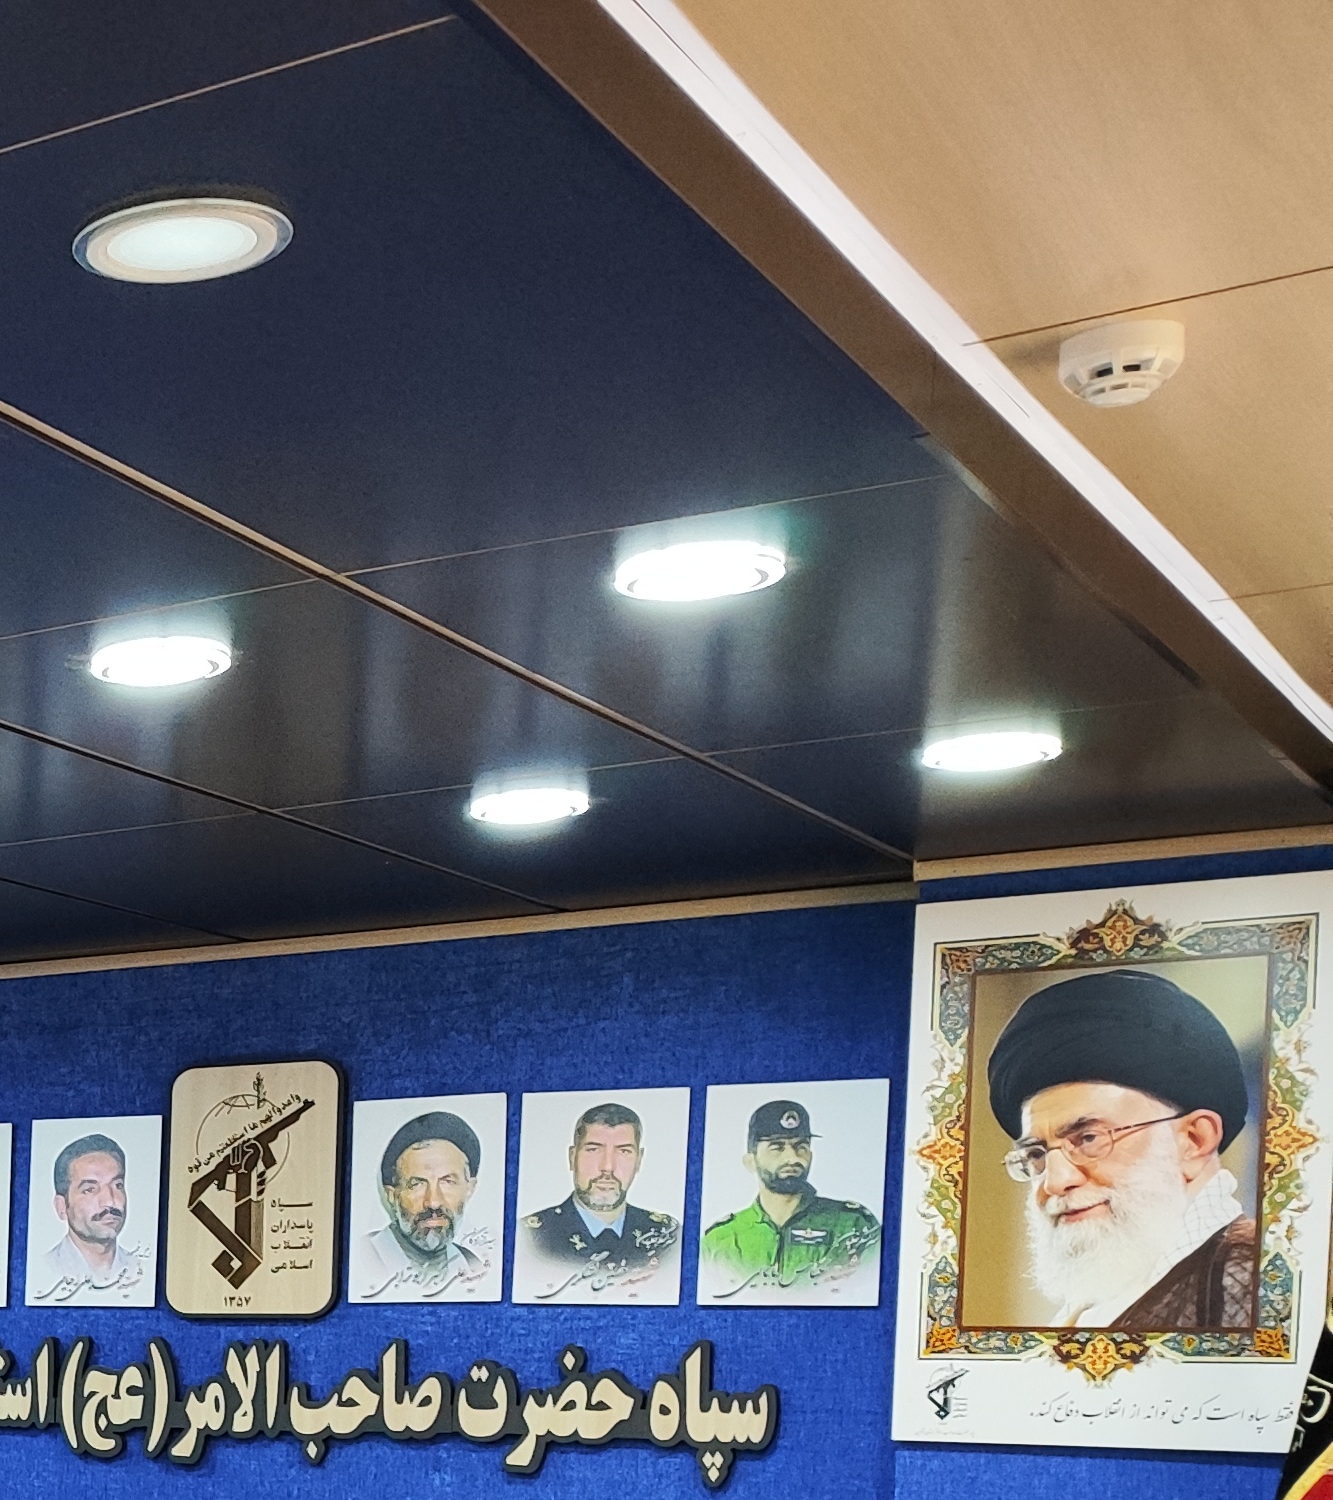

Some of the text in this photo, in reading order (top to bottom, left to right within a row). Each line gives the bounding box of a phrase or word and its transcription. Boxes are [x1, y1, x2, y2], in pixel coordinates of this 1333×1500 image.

[270, 1219, 314, 1234] پاسداران
[270, 1236, 314, 1254] انقلاب
[223, 1295, 252, 1308] ۱۳۵۷
[61, 1340, 169, 1453] (عج)
[170, 1342, 281, 1459] الامر
[290, 1342, 443, 1461] صاحب
[458, 1350, 635, 1467] حضرت
[1190, 1393, 1222, 1421] که
[649, 1346, 769, 1482] سپاه
[1052, 1399, 1081, 1424] دفاع
[1080, 1398, 1126, 1426] انقلاب
[1128, 1402, 1141, 1420] از
[1171, 1405, 1190, 1425] می
[1205, 1406, 1245, 1421] است
[1247, 1407, 1271, 1434] سپاه
[1273, 1401, 1295, 1423] فقط
